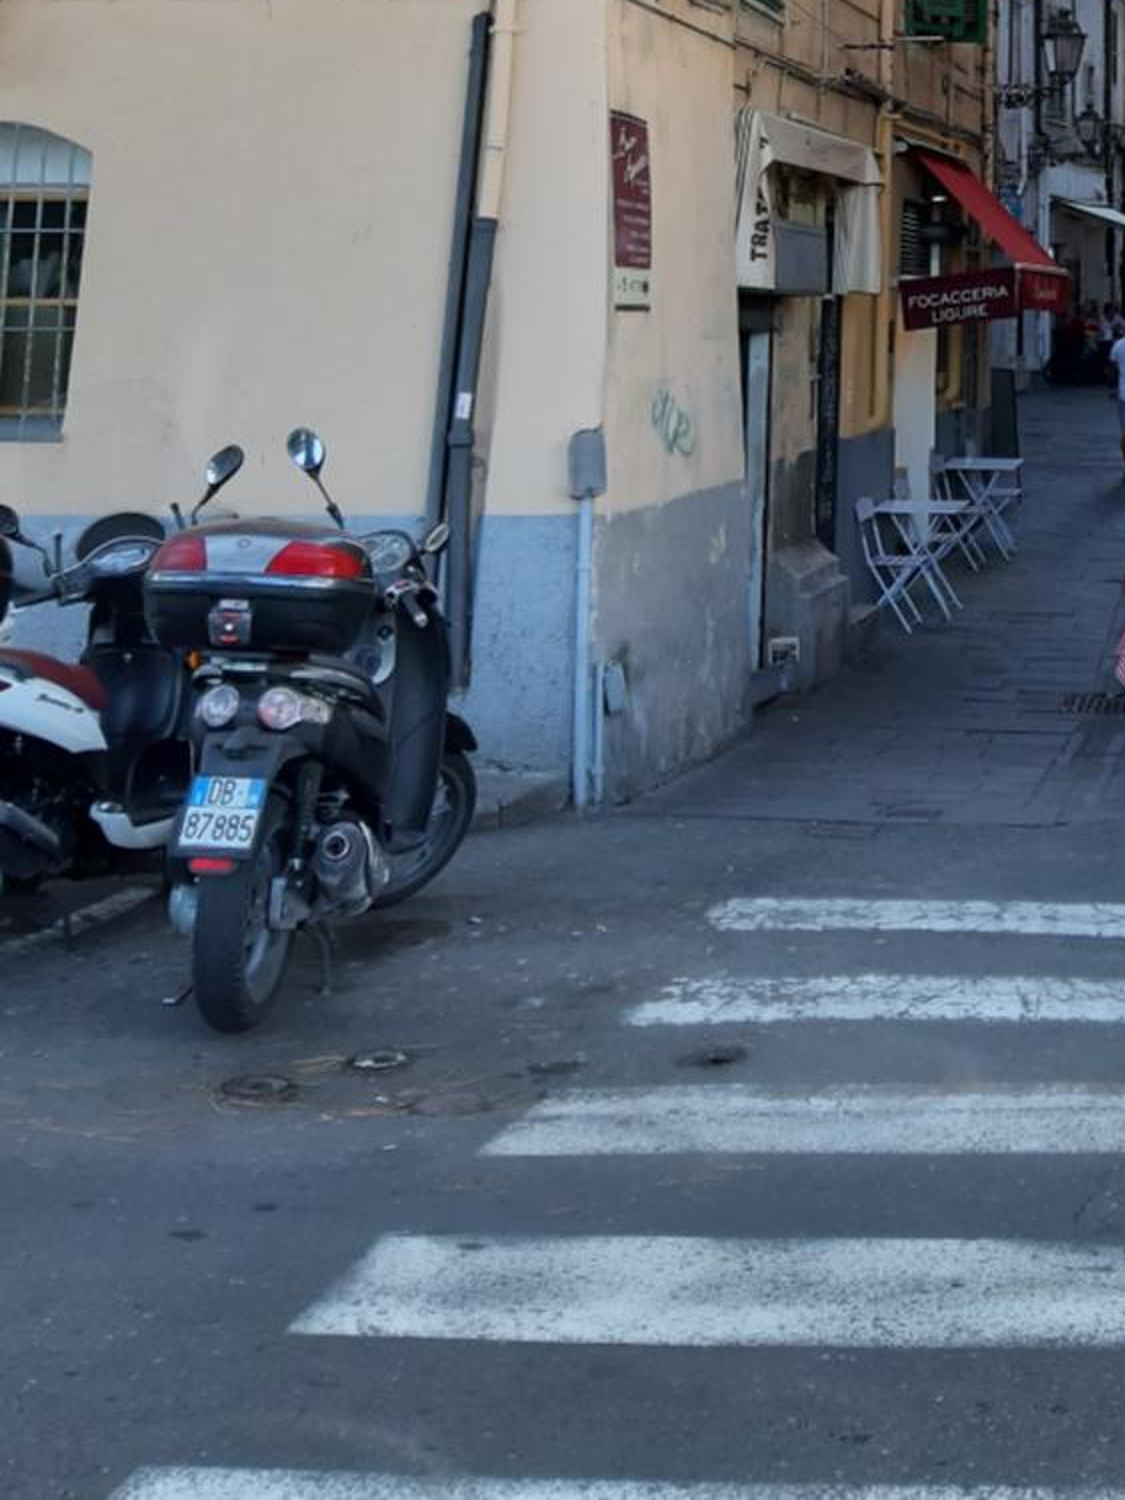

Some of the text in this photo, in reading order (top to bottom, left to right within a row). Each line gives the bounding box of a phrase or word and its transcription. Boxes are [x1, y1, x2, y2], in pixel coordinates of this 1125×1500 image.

[908, 285, 1009, 310] FOCACCERIA
[931, 303, 989, 323] LIGURE
[208, 779, 237, 805] DB
[184, 812, 254, 842] 87885
